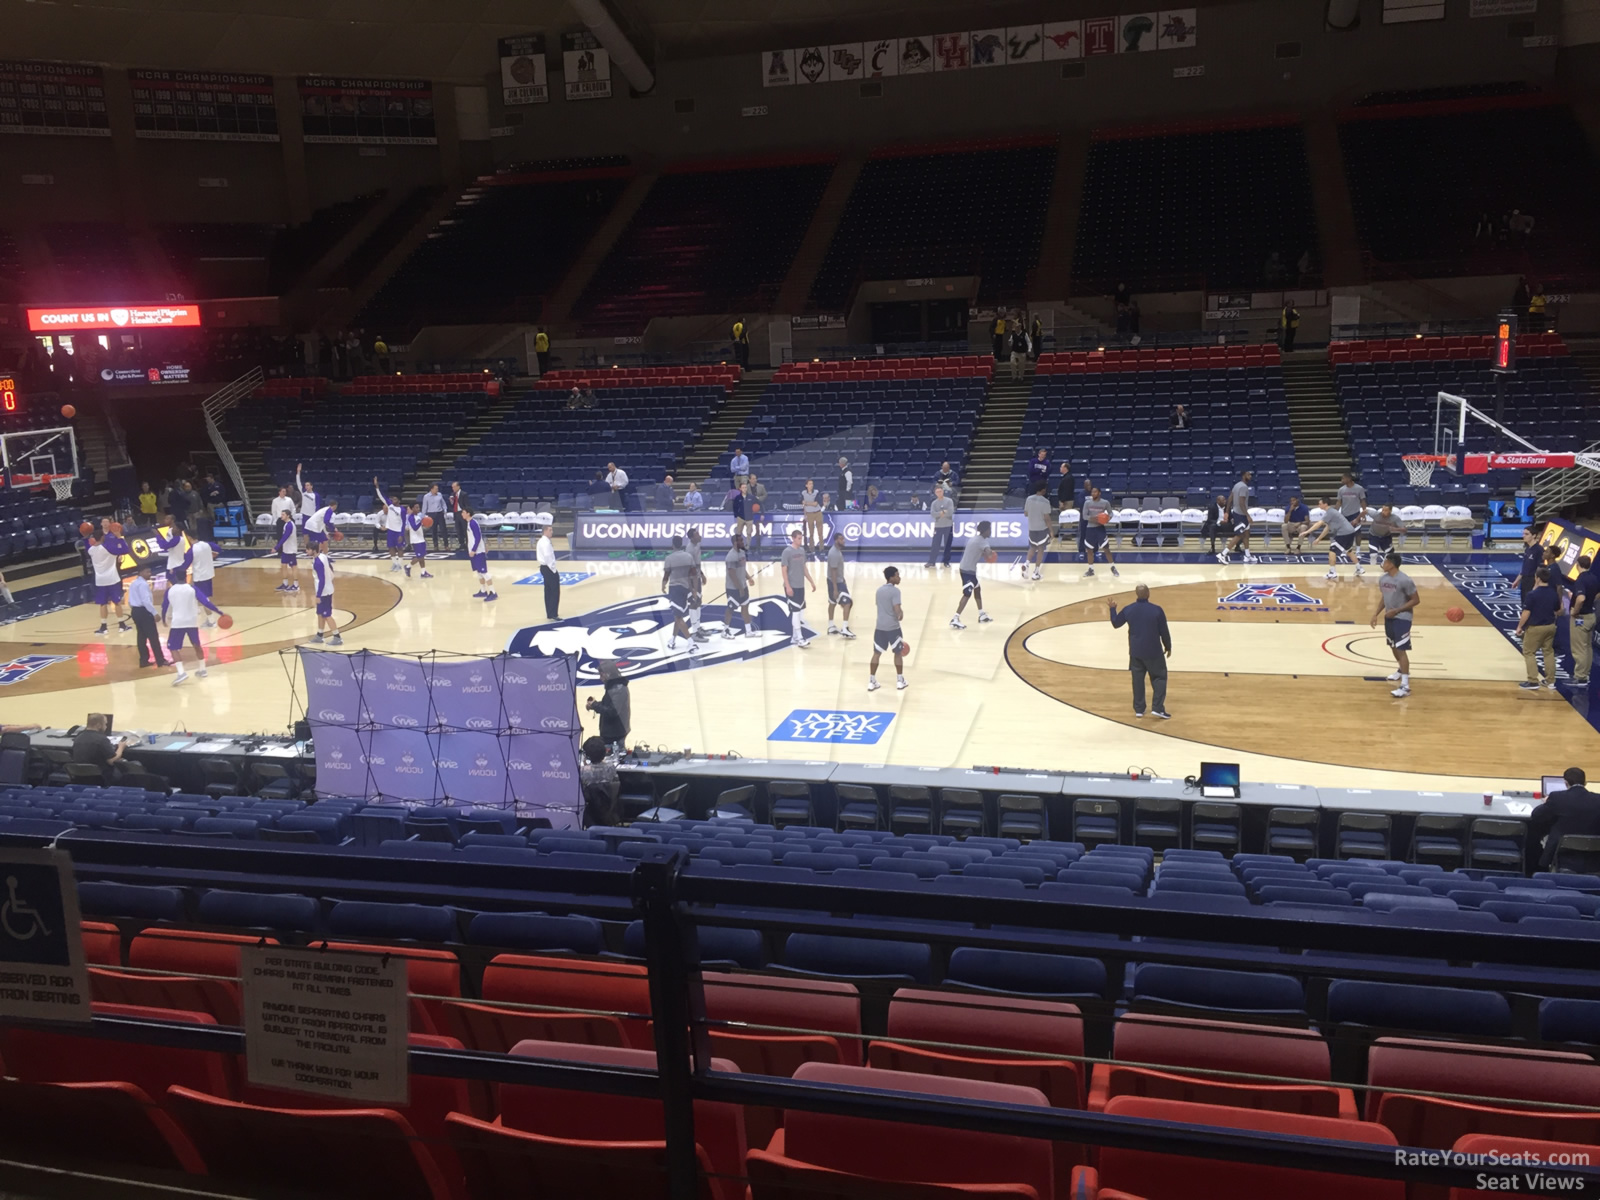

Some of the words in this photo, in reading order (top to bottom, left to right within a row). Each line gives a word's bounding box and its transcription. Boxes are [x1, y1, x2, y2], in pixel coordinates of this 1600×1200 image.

[176, 72, 265, 84] CHAMPIONSHIP
[341, 80, 425, 89] CHAMPIONSHIP
[41, 314, 79, 324] COUNT
[82, 313, 95, 323] US
[97, 313, 109, 322] IN
[1220, 310, 1239, 319] 222
[626, 336, 641, 344] 220
[844, 522, 1022, 541] @UCONNUSIES
[1216, 605, 1330, 613] AMERICAN
[805, 713, 880, 723] NEW
[791, 719, 882, 733] YORK
[791, 728, 866, 740] LIFE
[265, 957, 282, 966] PER
[284, 959, 311, 969] STATE
[313, 961, 352, 973] BUILDING
[253, 967, 284, 978] CHAIRS
[286, 969, 311, 981] MUST
[313, 973, 345, 984] REMAIN
[347, 976, 394, 988] FASTENED
[292, 983, 304, 991] AT
[306, 984, 322, 994] ALL
[32, 990, 80, 1005] SEATING
[262, 1001, 295, 1013] ANYONE
[297, 1005, 350, 1019] SEPARATING
[352, 1011, 386, 1022] CHAIRS
[262, 1012, 299, 1025] WITHOUT
[301, 1017, 326, 1028] PRIOR
[328, 1021, 375, 1033] APPROVAL
[377, 1026, 388, 1034] IS
[263, 1024, 301, 1036] SUBJECT
[303, 1029, 315, 1038] TO
[316, 1031, 357, 1044] REMOVAL
[360, 1035, 386, 1046] FROM
[295, 1039, 311, 1049] THE
[271, 1058, 285, 1067] WE
[287, 1060, 314, 1072] THANK
[316, 1064, 333, 1075] YOU
[335, 1067, 352, 1077] FOR
[354, 1069, 379, 1080] YOUR
